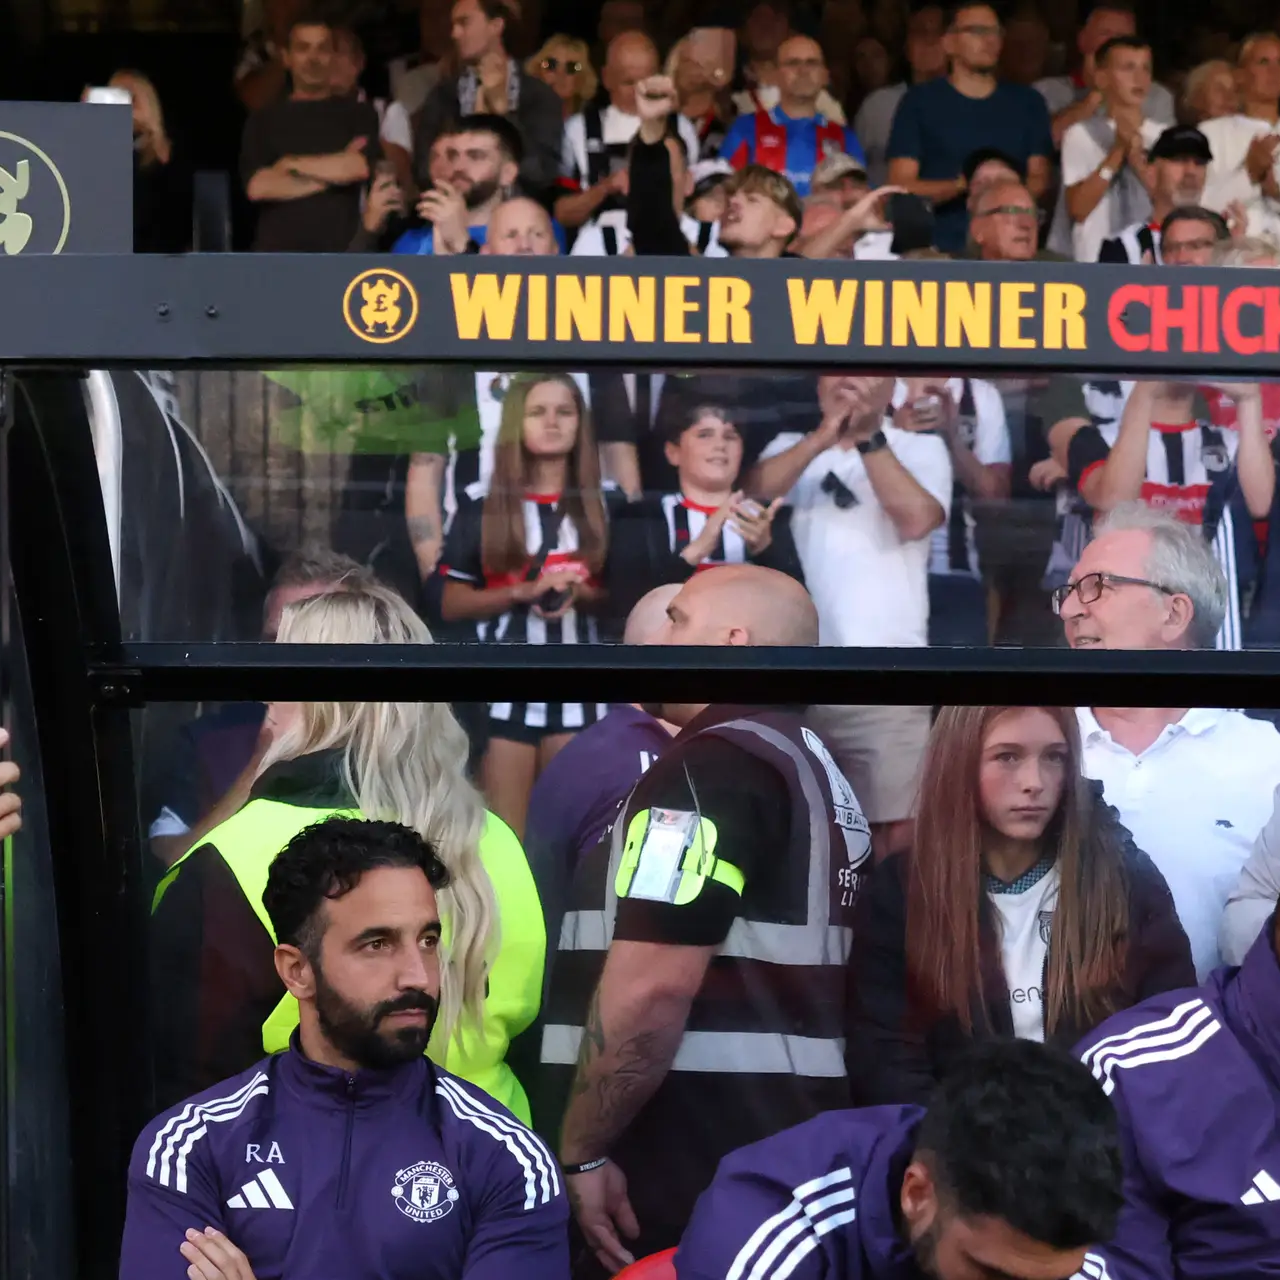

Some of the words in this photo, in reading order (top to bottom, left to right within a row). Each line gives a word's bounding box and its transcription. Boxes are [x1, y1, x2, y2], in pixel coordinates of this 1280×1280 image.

[450, 273, 752, 343] WINNER
[787, 279, 1086, 349] WINNER
[245, 1141, 286, 1164] RA
[399, 1164, 454, 1186] MANCHESTER
[404, 1205, 444, 1219] UNITED
